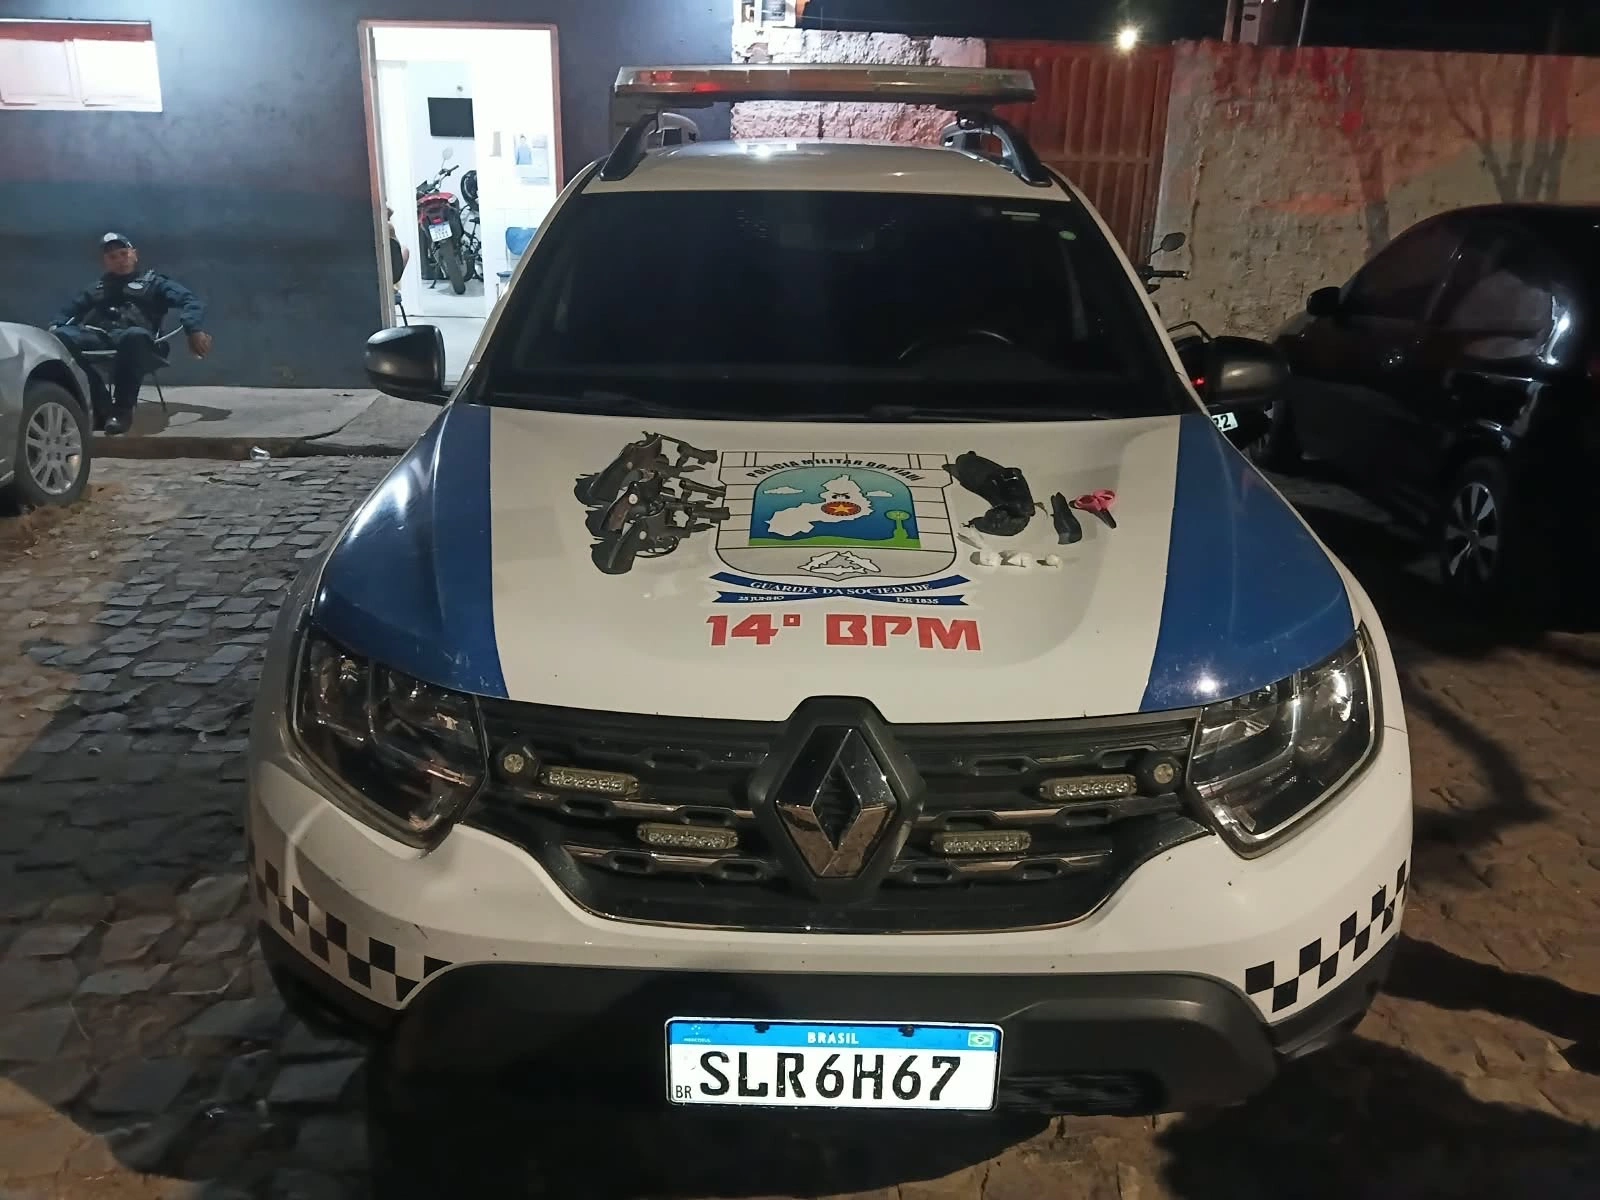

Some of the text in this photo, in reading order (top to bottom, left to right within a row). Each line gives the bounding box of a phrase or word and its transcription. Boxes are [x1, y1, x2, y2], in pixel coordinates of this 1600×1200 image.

[847, 584, 932, 595] SOCIEDADE
[826, 614, 981, 651] BPM
[807, 1031, 859, 1045] BRASIL
[700, 1050, 961, 1101] SLR6H67
[675, 1085, 692, 1099] BR
